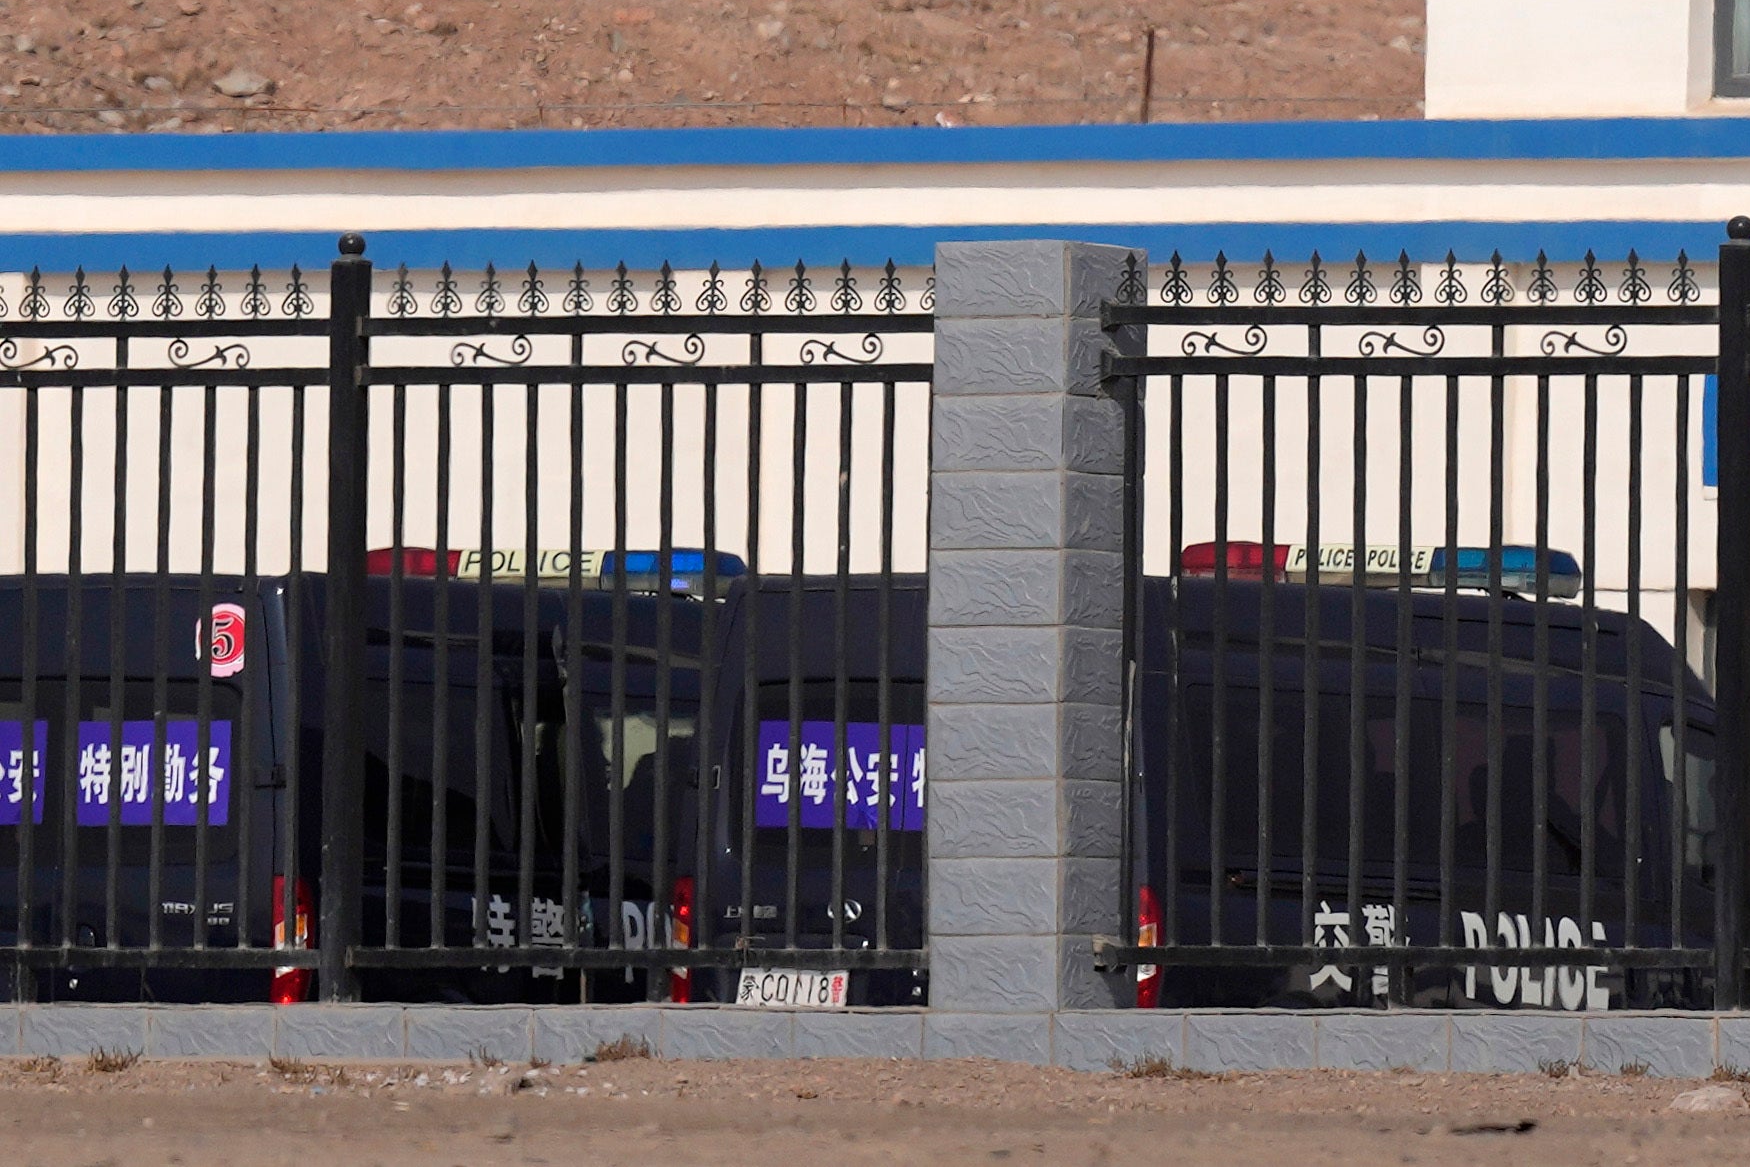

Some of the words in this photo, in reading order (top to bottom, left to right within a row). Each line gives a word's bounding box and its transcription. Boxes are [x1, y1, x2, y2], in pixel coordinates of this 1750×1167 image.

[464, 550, 595, 573] POLICE
[1294, 547, 1354, 568] PLICE
[0, 749, 40, 804] 安
[80, 743, 225, 805] 特别勤务
[1460, 910, 1610, 1011] POLICE
